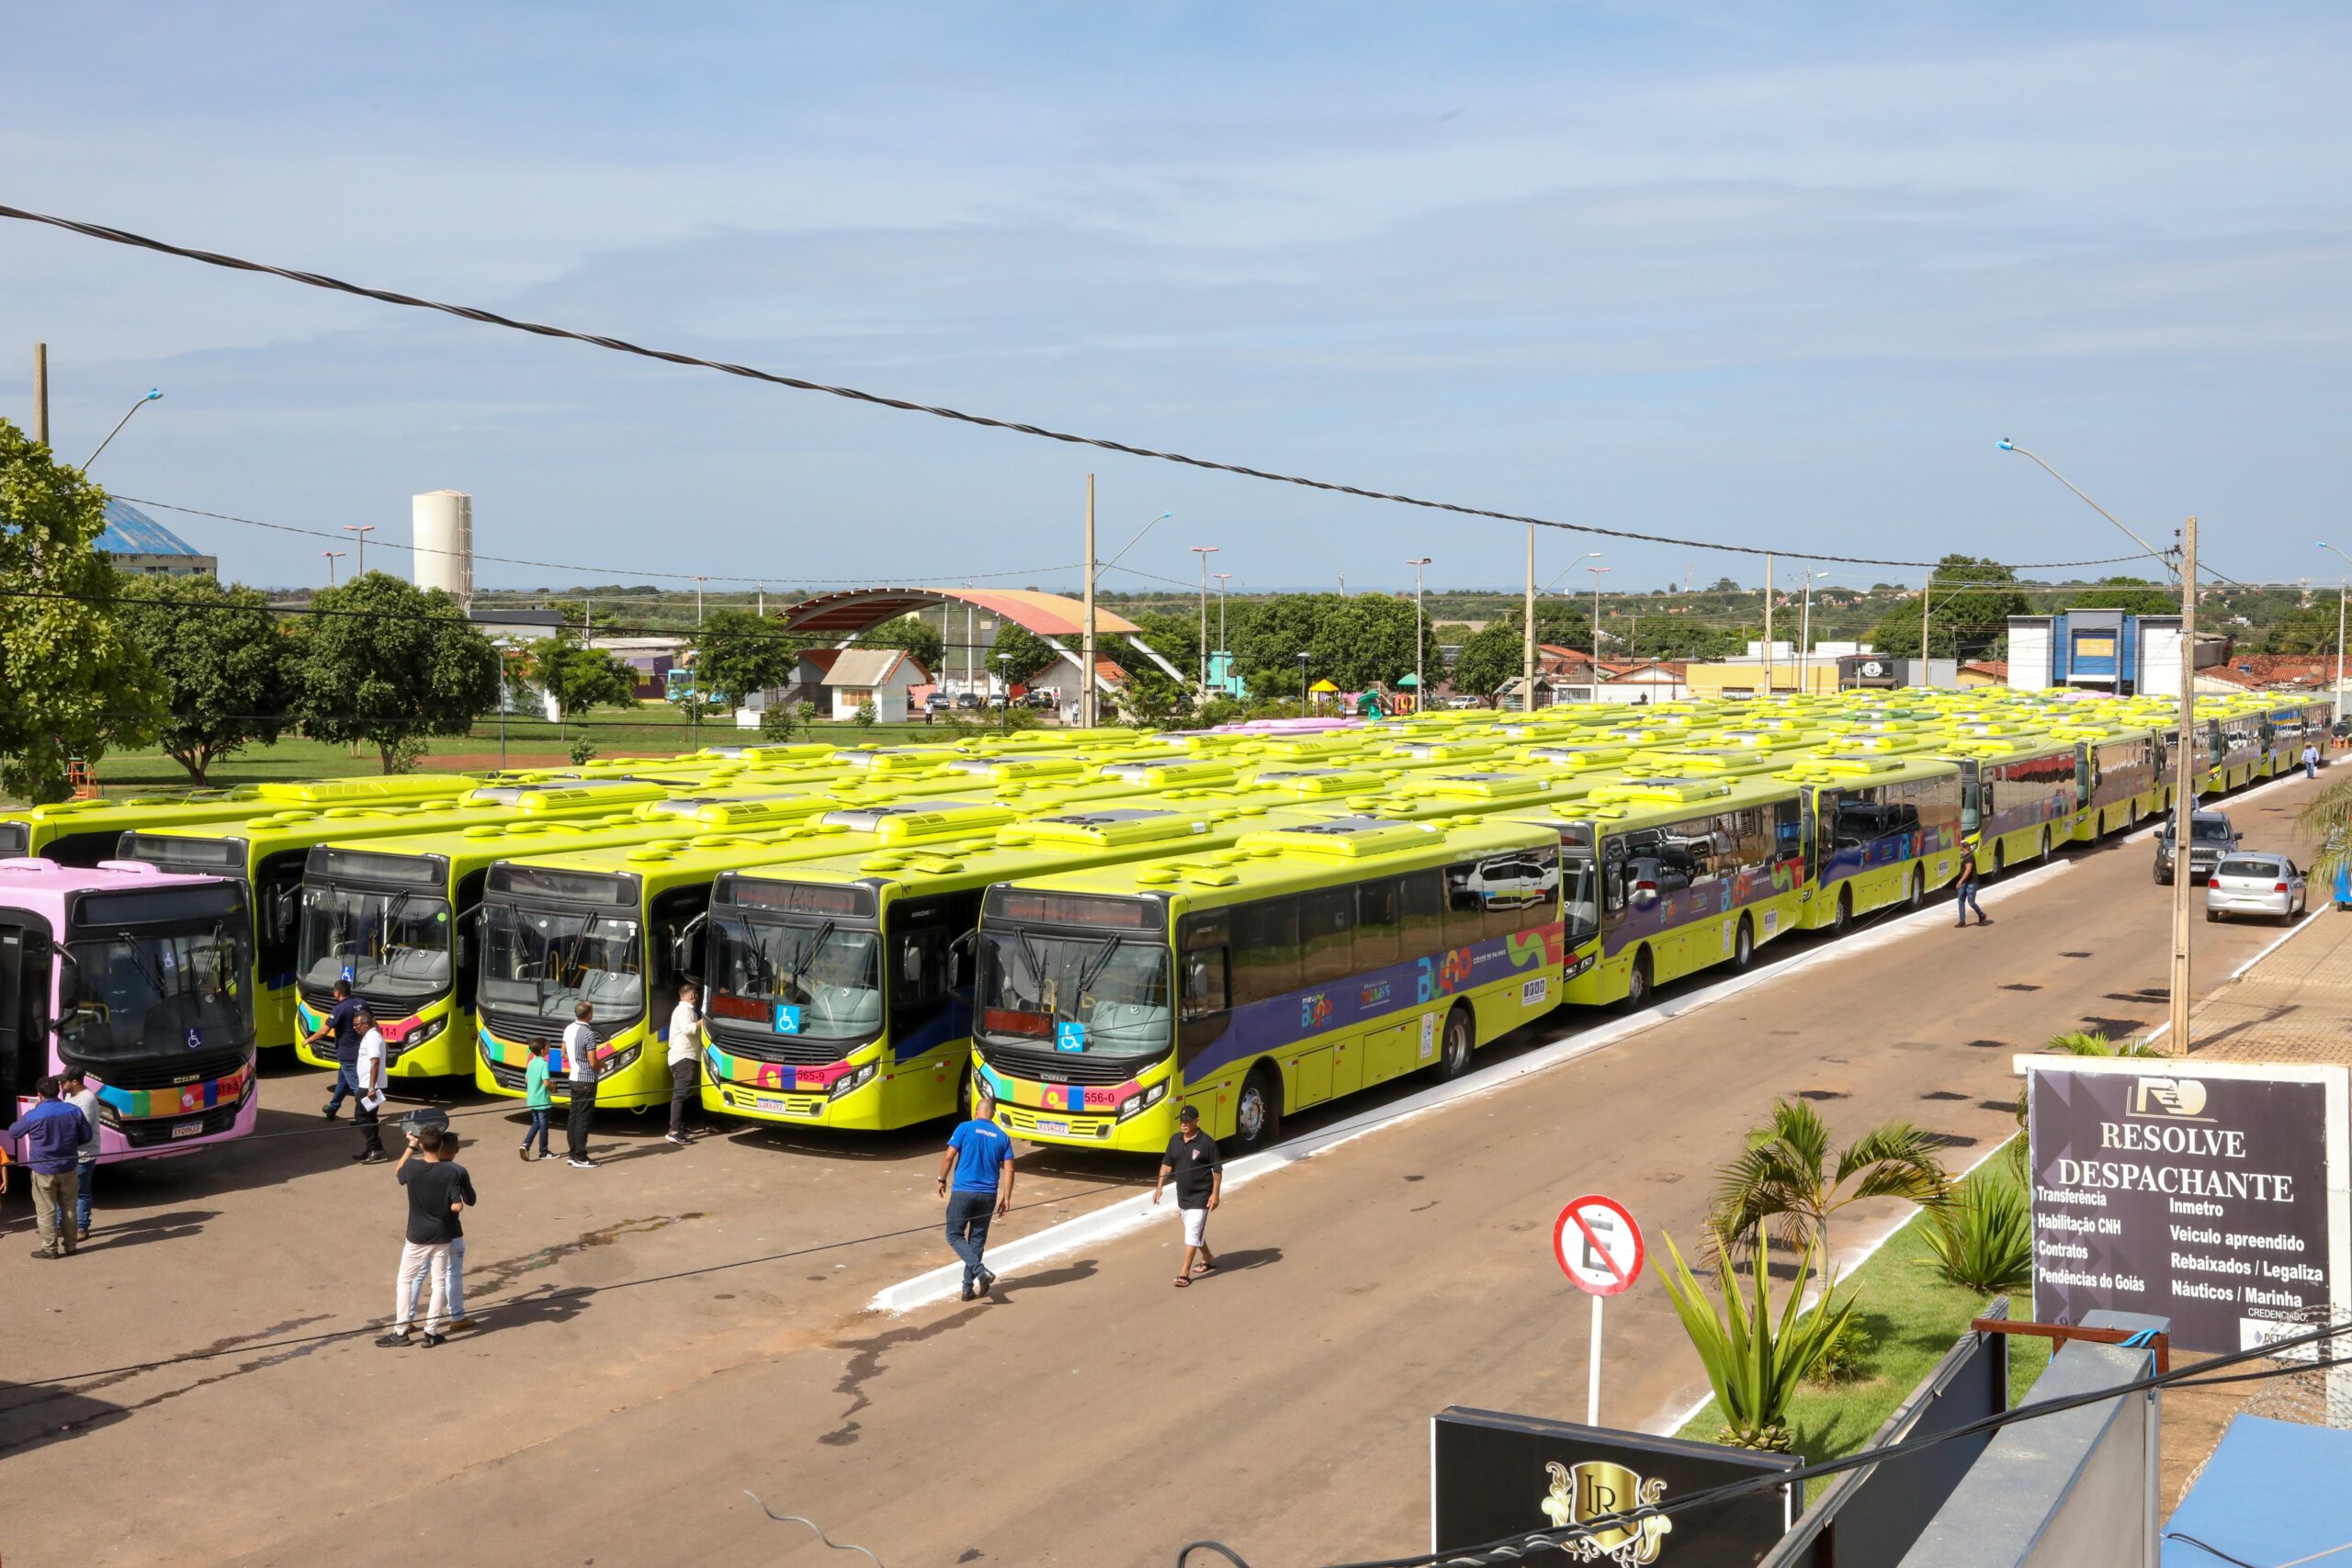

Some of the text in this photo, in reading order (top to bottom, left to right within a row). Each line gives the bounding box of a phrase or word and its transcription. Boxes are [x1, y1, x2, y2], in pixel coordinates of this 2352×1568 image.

[797, 1069, 825, 1081] 565-9
[1084, 1092, 1115, 1103] 556-0
[2100, 1122, 2246, 1158] RESOLVE
[2058, 1158, 2294, 1202] DESPACHANTE
[2037, 1186, 2108, 1207] Transferência
[2169, 1197, 2223, 1217] Inmetro
[2038, 1213, 2121, 1235] Habilitação CNH
[2169, 1224, 2305, 1252] Veiculo apreendido
[2039, 1240, 2088, 1259] Contratos
[2171, 1252, 2252, 1275] Rebaixados
[2263, 1260, 2324, 1282] Legaliza
[2039, 1267, 2145, 1292] Pendências do Goiás
[2171, 1280, 2233, 1301] Náuticos
[2245, 1287, 2302, 1308] Marinha
[2248, 1307, 2309, 1323] CREDENCIADO:
